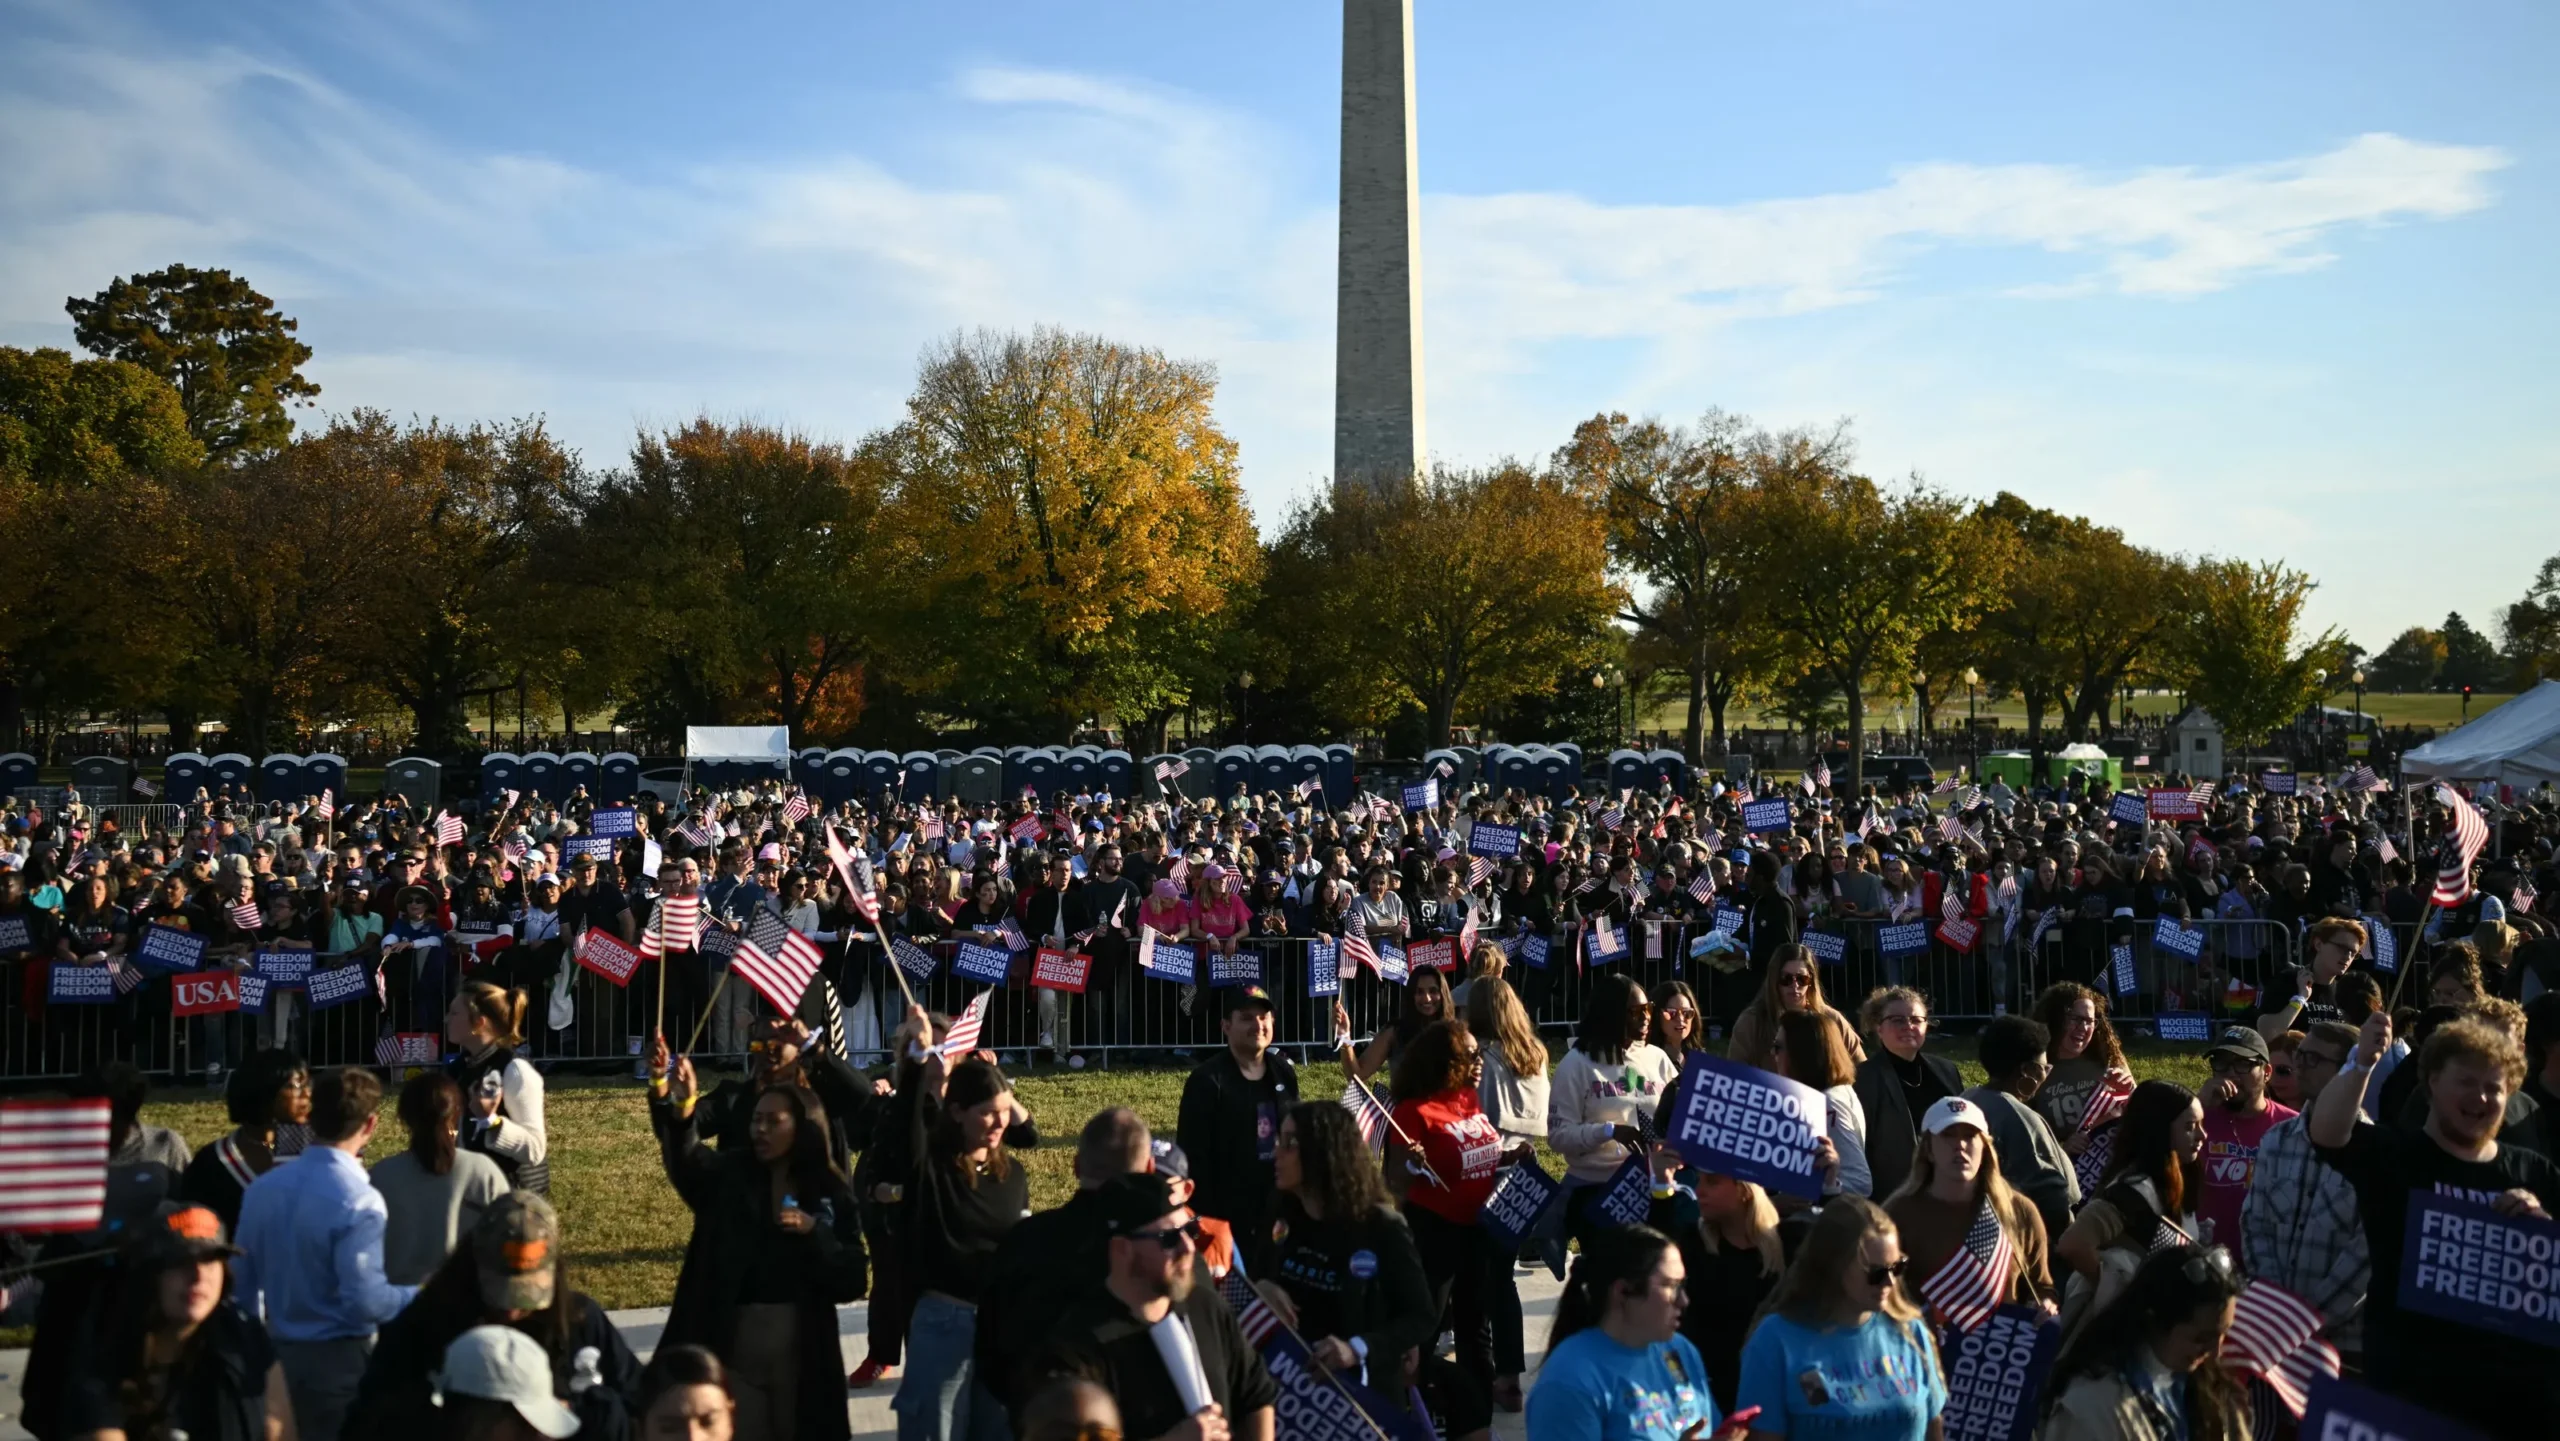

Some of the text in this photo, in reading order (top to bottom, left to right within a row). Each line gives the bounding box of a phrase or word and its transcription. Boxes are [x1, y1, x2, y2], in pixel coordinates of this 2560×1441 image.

[2152, 792, 2189, 800] FREEDO
[1744, 802, 1784, 813] FREEDOM
[1745, 809, 1786, 821] FREEDOM
[2115, 802, 2145, 816] FREEDO
[2153, 806, 2197, 814] FREEDOM
[593, 811, 632, 821] FREEDOM
[594, 818, 633, 828] FREEDOM
[1746, 816, 1787, 828] FREEDOM
[2112, 809, 2144, 824] FREEDO
[594, 825, 633, 835] FREEDOM
[1011, 815, 1035, 835] FREEDOM
[1475, 825, 1518, 838] FREEDOM
[567, 838, 612, 848] FREEDOM
[1474, 833, 1516, 846] FREEDOM
[1472, 841, 1515, 854] FREEDOM
[1880, 922, 1925, 936] FREEDOM
[1940, 925, 1970, 948] FREEDOM
[150, 928, 203, 949] FREEDOM
[1802, 932, 1846, 946] FREEDOM
[1881, 930, 1926, 944] FREEDOM
[2158, 926, 2201, 949] FREEDOM
[2374, 920, 2384, 966] FREEDOM
[145, 937, 200, 958] FREEDOM
[592, 933, 638, 964] FREEDOM
[962, 942, 1009, 962] FREEDOM
[1882, 938, 1927, 952] FREEDOM
[2156, 934, 2199, 957] FREEDOM
[142, 945, 197, 967] FREEDOM
[259, 953, 312, 963] FREEDOM
[587, 941, 633, 971] FREEDOM
[893, 938, 937, 968] FREEDOM
[1411, 950, 1452, 964] FREEDOM
[258, 962, 312, 972] FREEDOM
[586, 952, 629, 979] REEDOM
[959, 951, 1006, 971] FREEDOM
[1212, 962, 1260, 971] FREEDOM
[1314, 944, 1322, 992] FREEDOM
[1321, 944, 1330, 991] FREEDOM
[1329, 942, 1338, 990] FREEDOM
[54, 967, 110, 977] FREEDOM
[308, 963, 361, 985] FREEDOM
[957, 960, 1004, 980] FREEDOM
[1038, 962, 1084, 977] FREEDOM
[1213, 970, 1260, 980] FREEDOM
[54, 977, 110, 986] FREEDOM
[309, 972, 363, 994] FREEDOM
[1036, 971, 1082, 986] FREEDOM
[53, 987, 110, 996] FREEDOM
[176, 980, 237, 1006] USA
[312, 980, 366, 1003] FREEDOM
[2159, 1018, 2206, 1026] FREEDOM
[2160, 1026, 2207, 1034] FREEDOM
[1687, 1094, 1821, 1151] FREEDOM
[1680, 1119, 1815, 1177] FREEDOM
[2421, 1208, 2560, 1264] FREEDO
